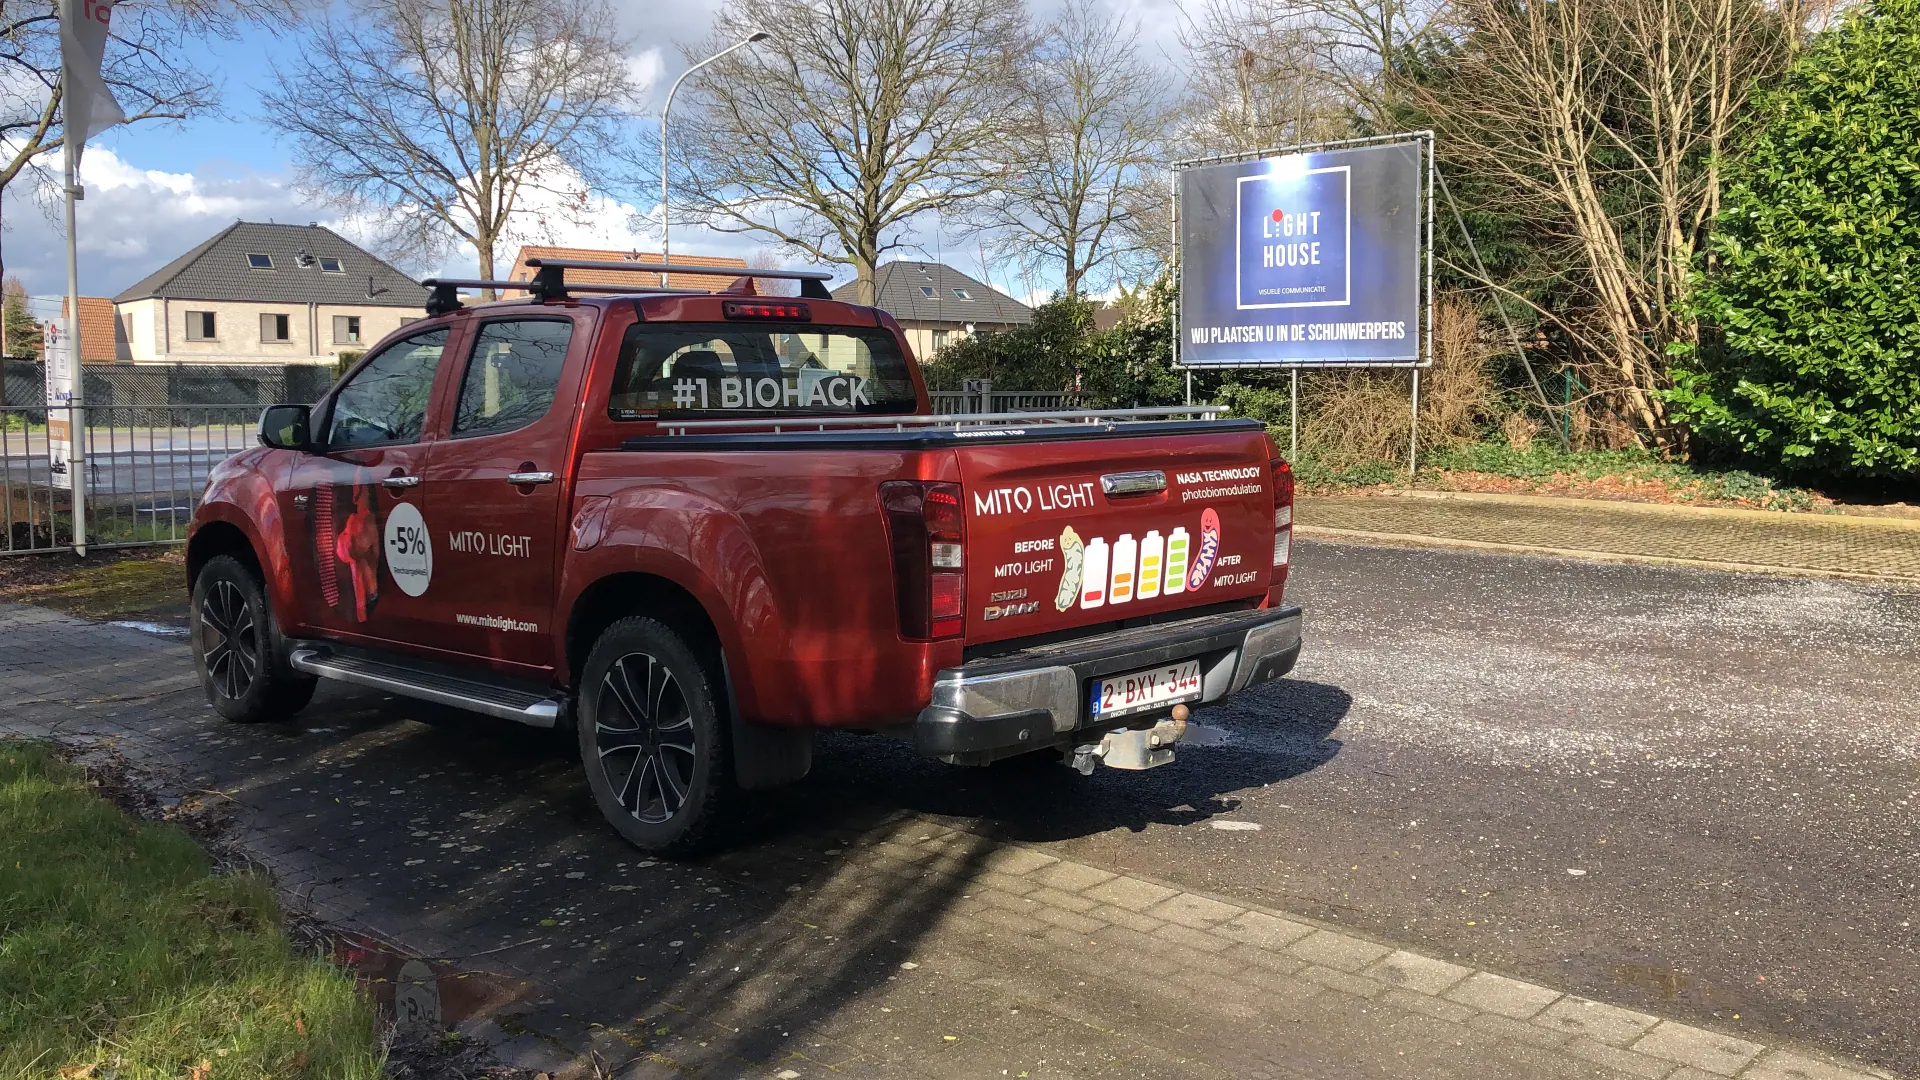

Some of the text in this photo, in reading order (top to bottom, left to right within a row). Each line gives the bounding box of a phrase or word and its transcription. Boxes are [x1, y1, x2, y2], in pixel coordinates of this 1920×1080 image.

[1263, 209, 1320, 238] LIGHT
[1263, 242, 1320, 268] HOUSE
[1258, 286, 1326, 296] VISUELE COMMUNICATIE
[1191, 321, 1405, 344] WIJ PLAATSEN U IN DE SCHIJNWERPERS
[672, 377, 870, 409] #1 BIOHACK
[1176, 467, 1260, 484] NASA TECHNOLOGY
[974, 483, 1094, 516] MITO LIGHT
[1182, 483, 1261, 503] photobiomodulation
[389, 527, 425, 555] -5%
[449, 531, 531, 558] MITO LIGHT
[1015, 539, 1054, 553] BEFORE
[995, 559, 1053, 577] MITO LIGHT
[1216, 555, 1241, 567] AFTER
[1214, 571, 1257, 587] MITO LIGHT
[991, 588, 1027, 602] ISUZU
[456, 613, 538, 633] www.mitolight.com
[1092, 702, 1099, 713] B
